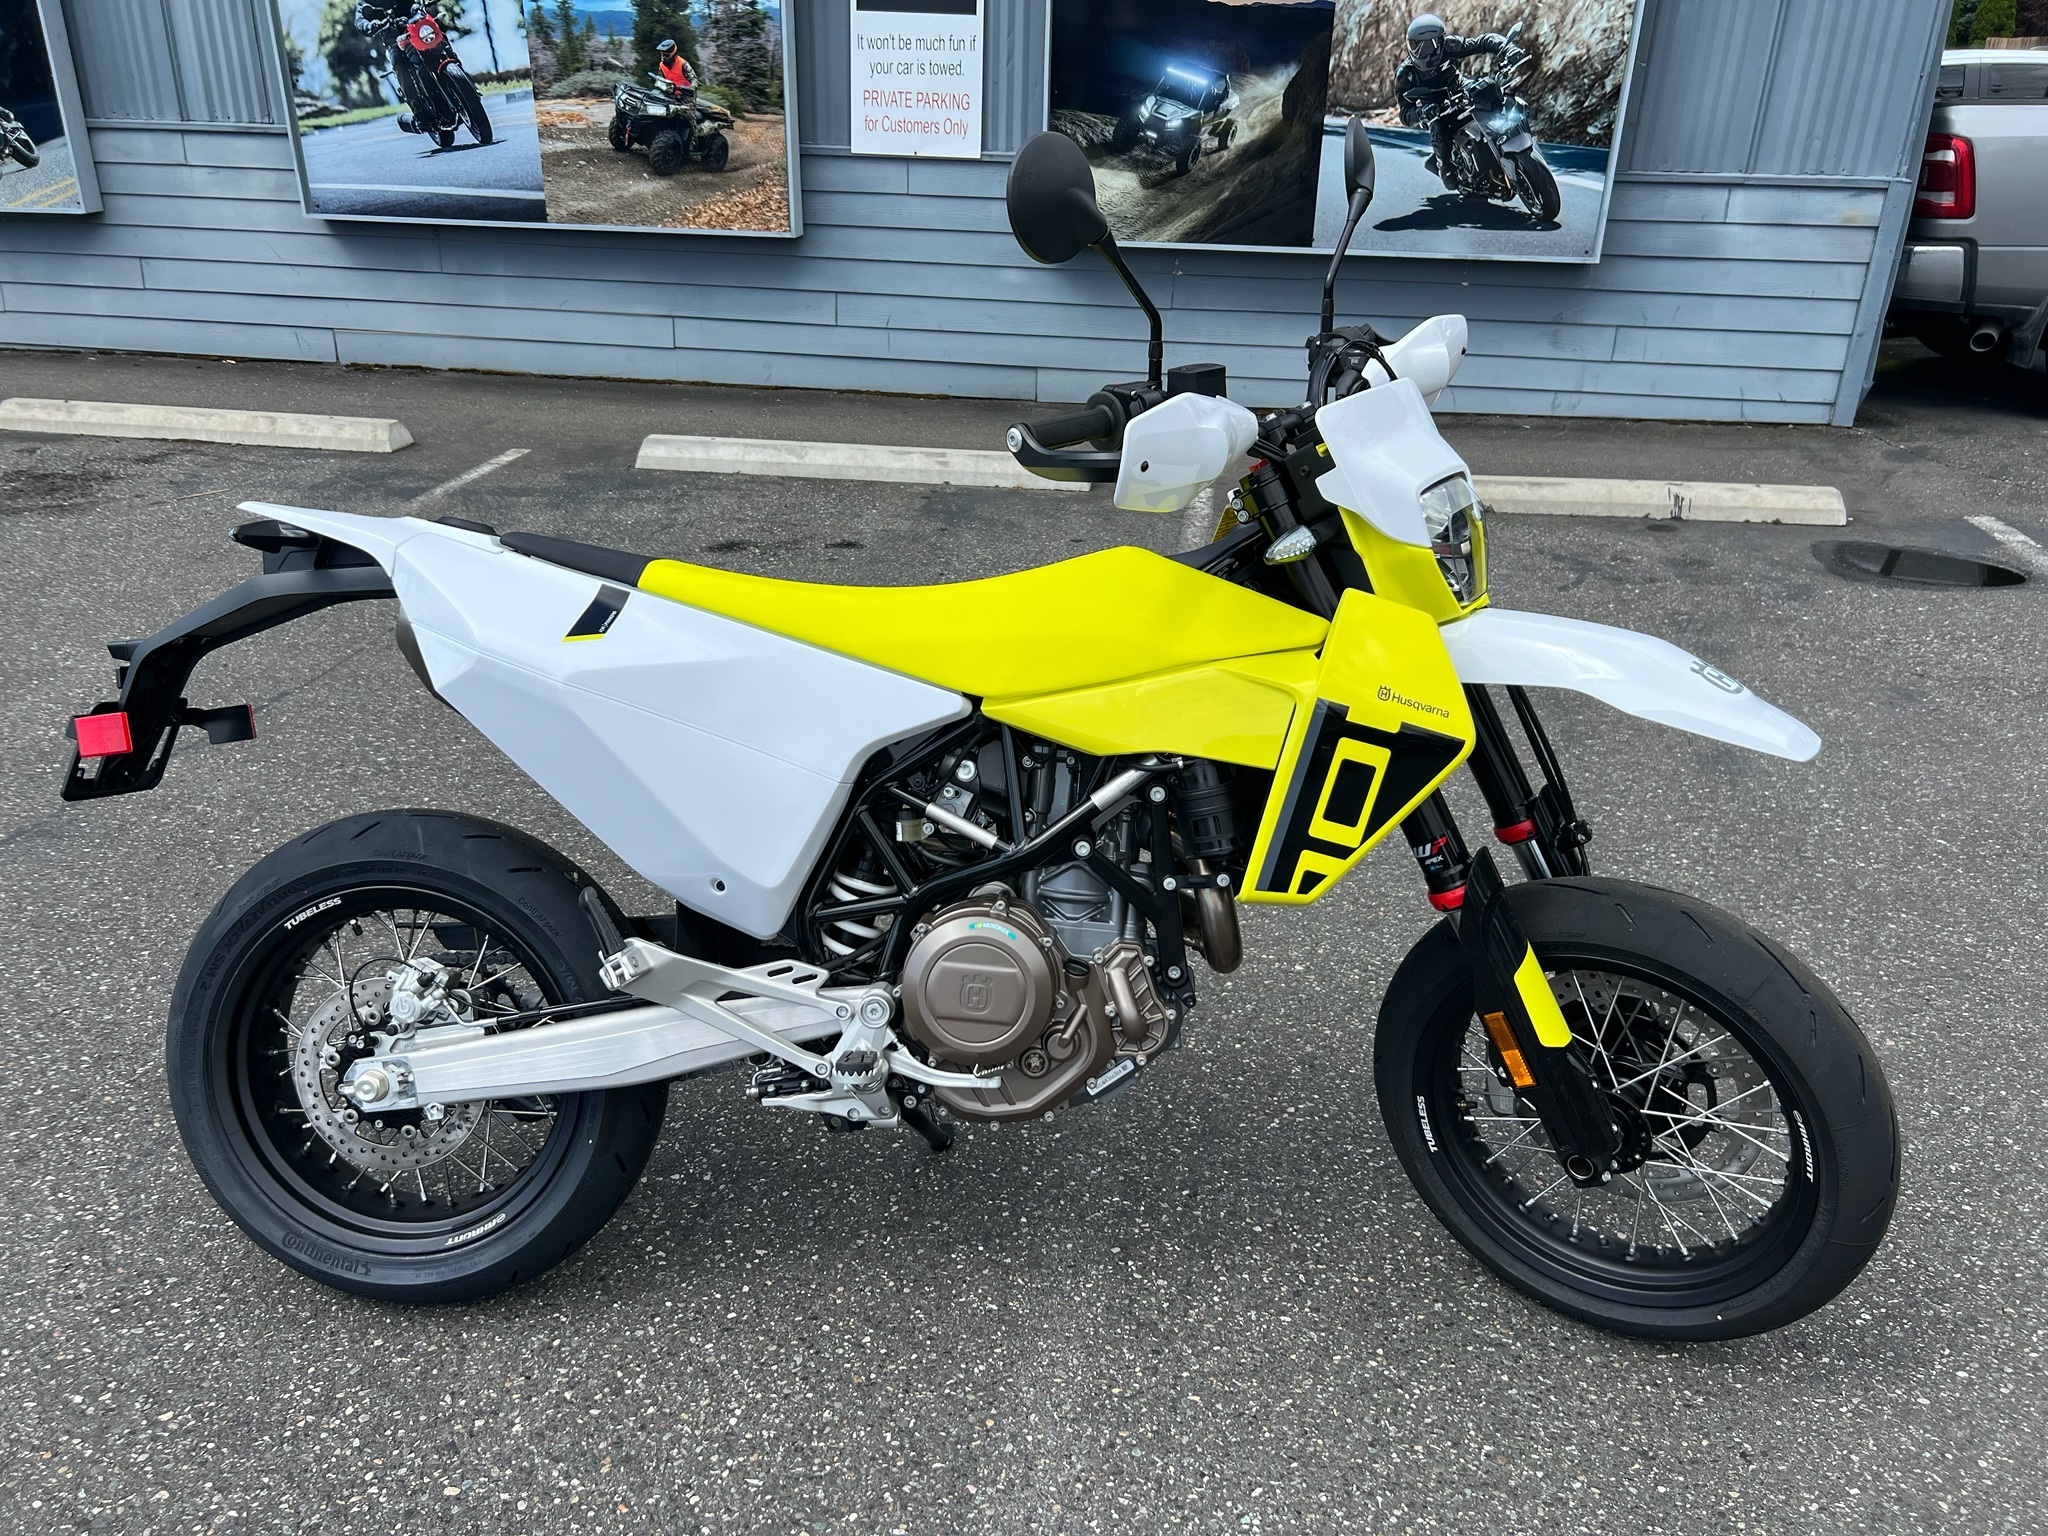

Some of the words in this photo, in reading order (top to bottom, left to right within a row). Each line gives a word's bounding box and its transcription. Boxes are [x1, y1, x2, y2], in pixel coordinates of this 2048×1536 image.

[857, 33, 864, 50] It
[867, 34, 896, 51] won't
[898, 34, 912, 51] be
[915, 34, 946, 51] much
[949, 34, 966, 52] fun
[969, 35, 977, 52] if
[869, 60, 894, 79] your
[896, 61, 914, 75] car
[917, 58, 926, 75] is
[929, 59, 965, 76] towed.
[863, 89, 913, 109] PRIVATE
[916, 92, 971, 111] PARKING
[864, 115, 879, 132] for
[881, 115, 940, 135] Customers
[943, 117, 969, 140] Only
[1391, 692, 1451, 719] Husqvarna
[284, 897, 342, 930] TUBELESS
[982, 922, 1011, 937] MOTOREX
[1417, 1095, 1438, 1153] TUBELESS
[281, 1231, 359, 1275] Continental
